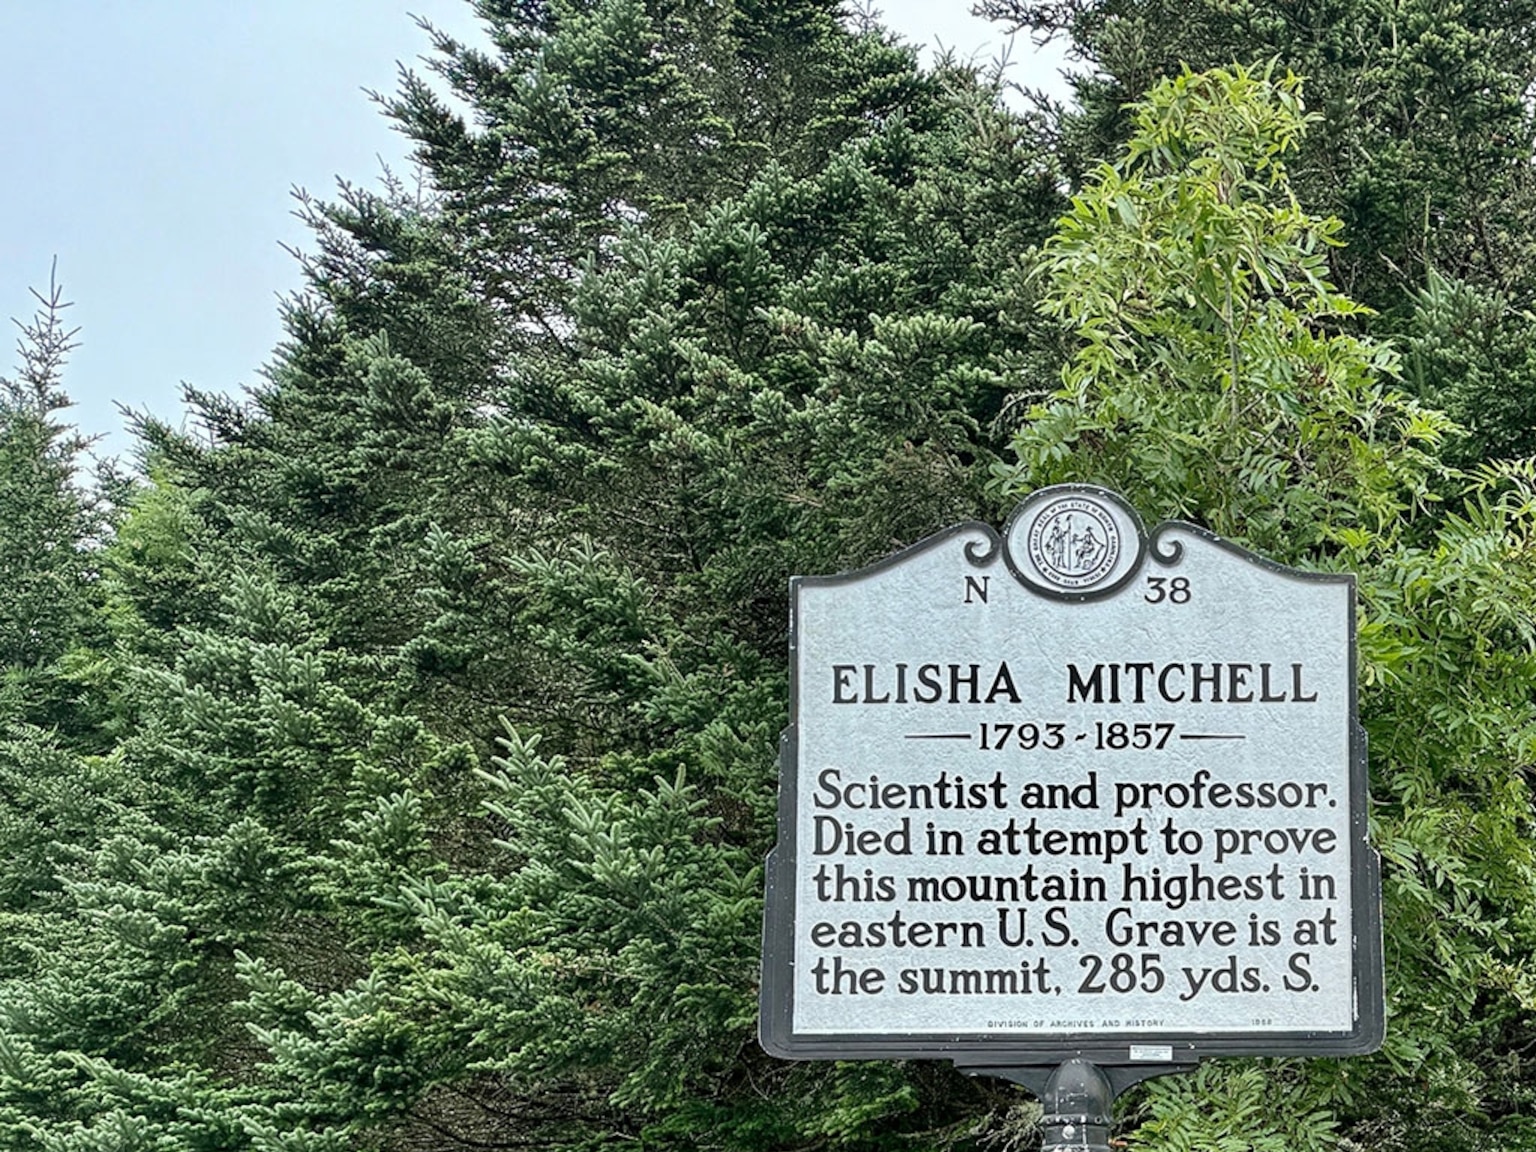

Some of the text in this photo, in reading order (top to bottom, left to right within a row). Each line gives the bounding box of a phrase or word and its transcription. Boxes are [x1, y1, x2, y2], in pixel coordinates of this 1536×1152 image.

[963, 575, 1192, 605] N 38
[832, 660, 1318, 704] ELISHA MITCHELL
[813, 768, 1336, 818] Scientist and professor.
[812, 815, 1337, 865] Died in attempt to prove
[812, 862, 1337, 910] this mountain highest in
[810, 906, 1337, 948] eastern U.S. Grave is at
[810, 952, 1320, 1002] the summit, 285 yds. S.
[988, 1020, 1028, 1028] DIVISION
[1034, 1020, 1044, 1028] OF
[1050, 1020, 1094, 1028] ARCHIVES
[1125, 1019, 1164, 1027] HISTORY
